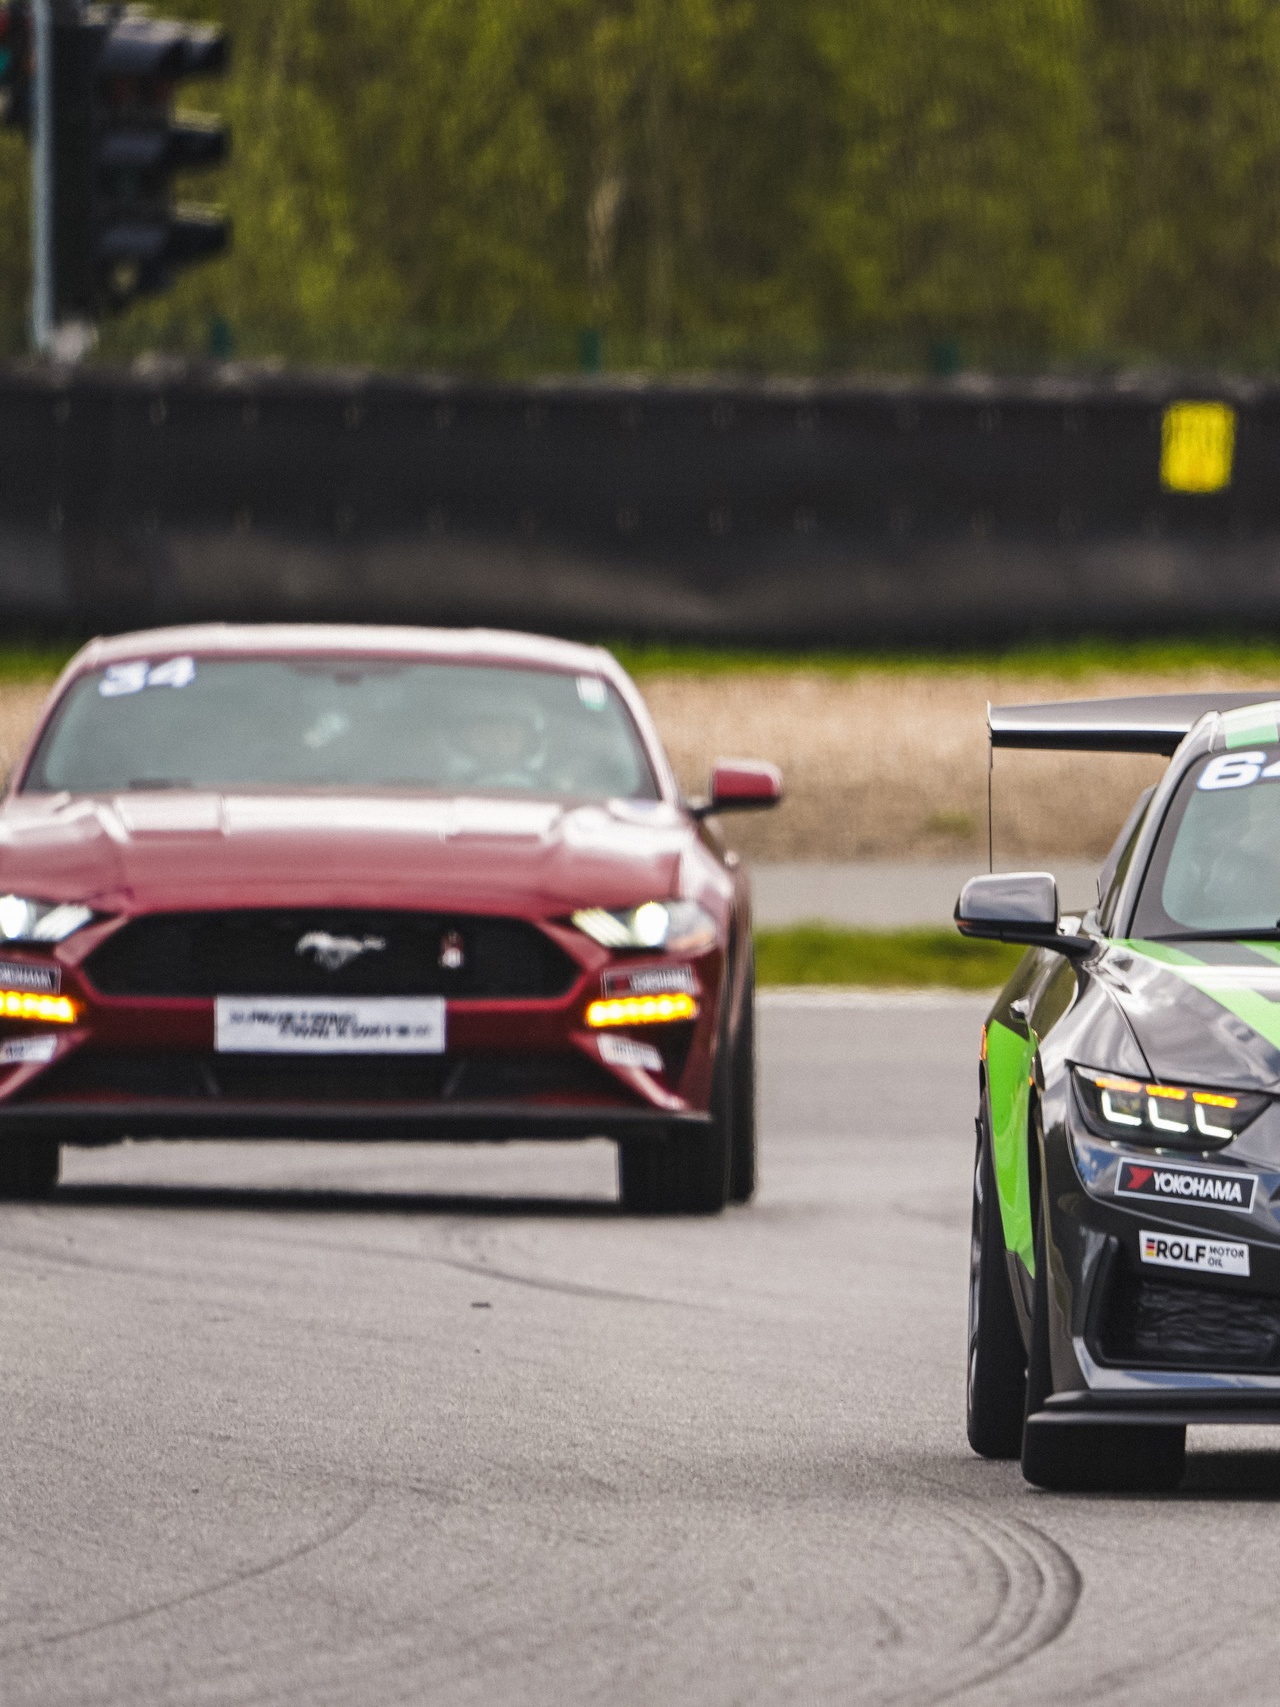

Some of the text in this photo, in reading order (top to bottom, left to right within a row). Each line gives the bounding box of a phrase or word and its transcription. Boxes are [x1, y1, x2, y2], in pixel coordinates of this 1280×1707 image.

[98, 657, 196, 697] 34
[1153, 1171, 1243, 1203] YOKOHAMA
[1156, 1239, 1244, 1263] ROLF MOTOR
[1208, 1258, 1223, 1268] OIL
